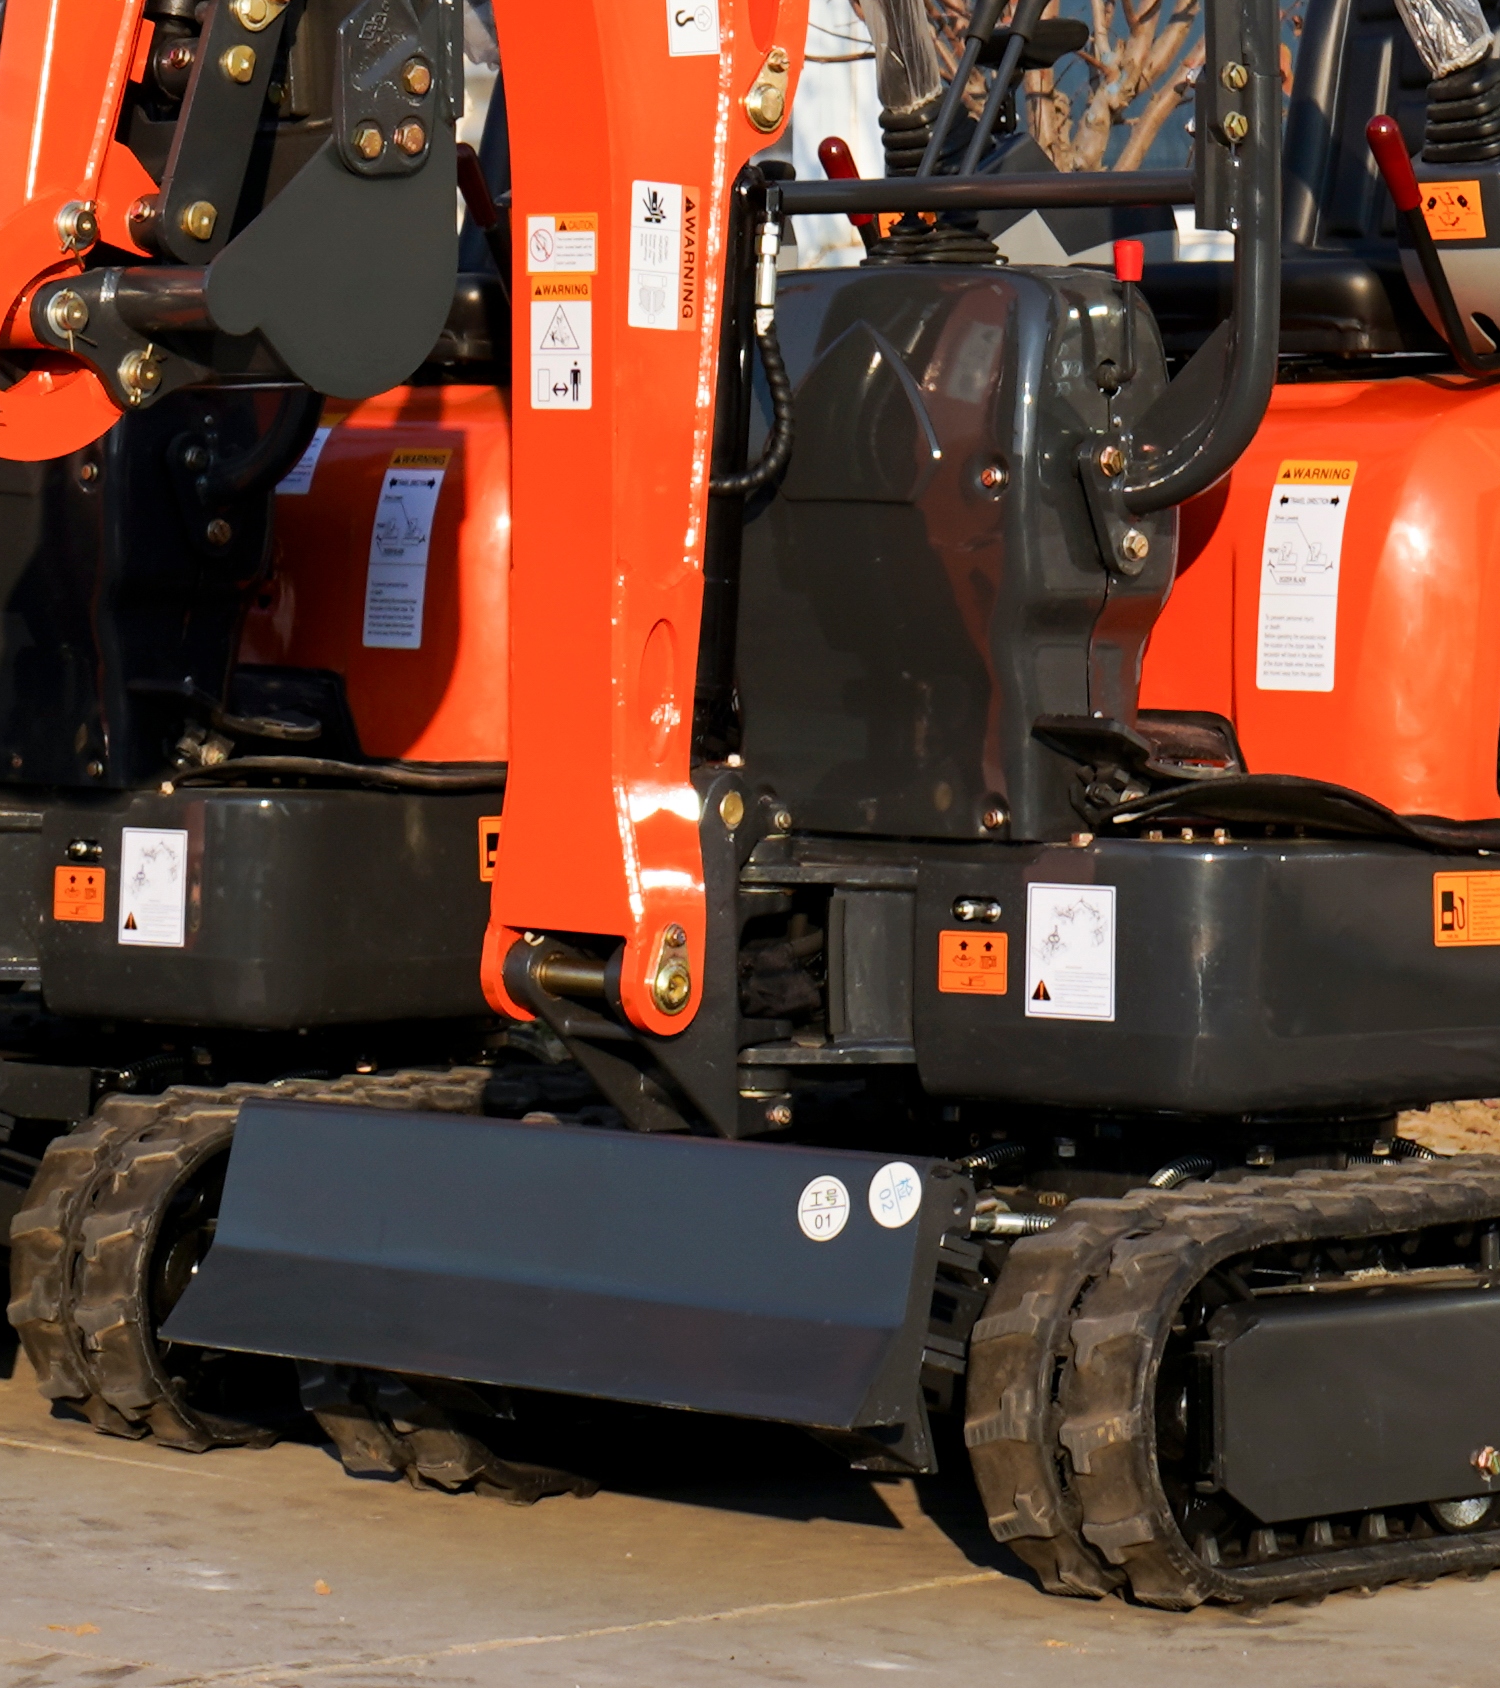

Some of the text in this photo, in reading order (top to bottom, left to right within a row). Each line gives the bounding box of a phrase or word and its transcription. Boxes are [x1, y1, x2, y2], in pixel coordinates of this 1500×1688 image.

[682, 215, 697, 319] WARNING
[543, 284, 589, 295] WARNING
[401, 454, 446, 466] WARNING
[1293, 467, 1351, 480] WARNING
[810, 1188, 839, 1208] 工号
[814, 1213, 831, 1230] 01
